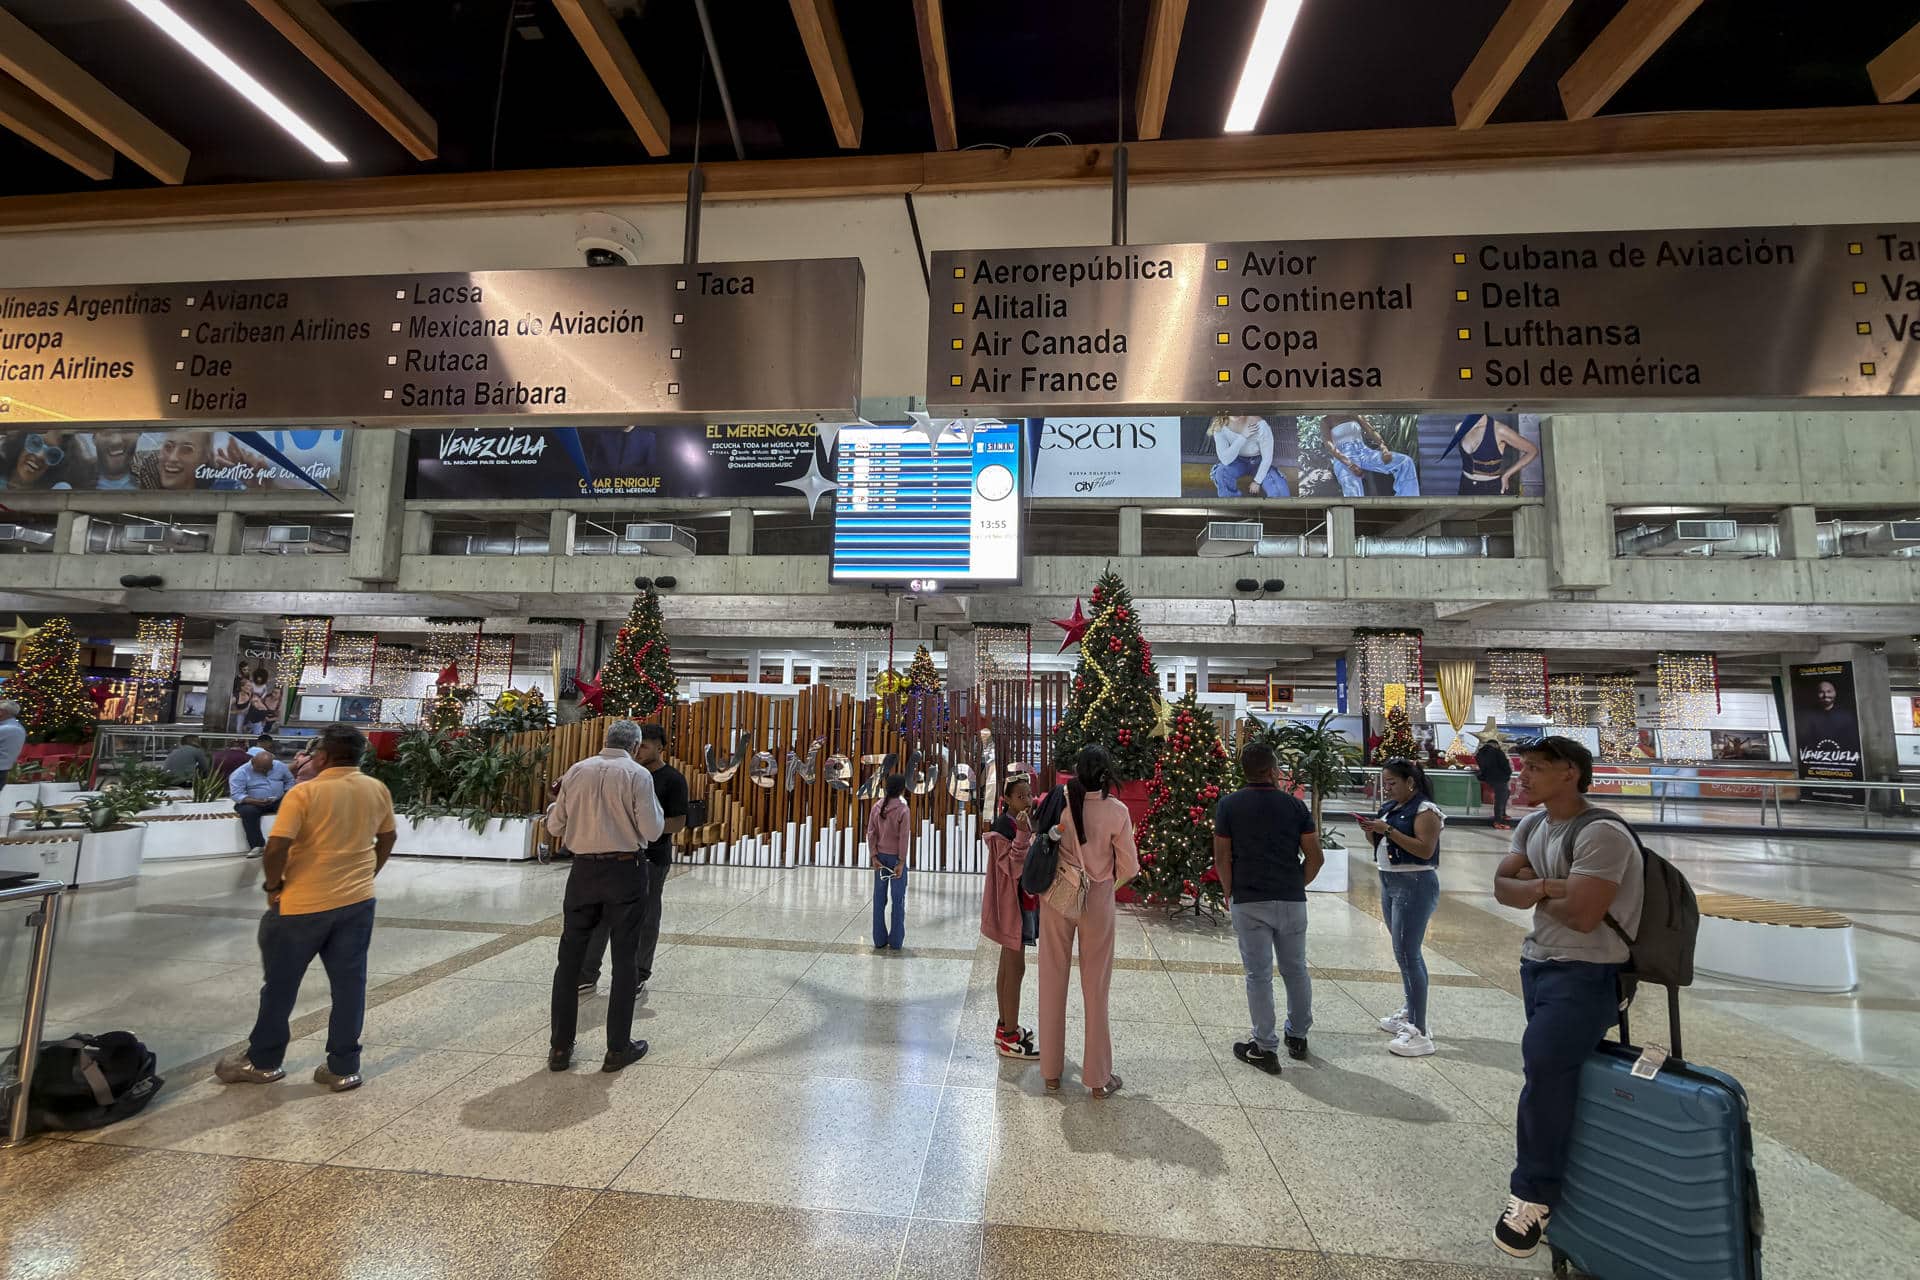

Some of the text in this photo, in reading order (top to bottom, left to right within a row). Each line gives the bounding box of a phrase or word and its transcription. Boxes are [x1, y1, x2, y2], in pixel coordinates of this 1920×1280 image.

[1478, 237, 1796, 272] Cubana de Aviación
[1876, 233, 1920, 262] Ta
[972, 255, 1174, 288] Aerorepública
[1241, 251, 1318, 276] Avior
[413, 281, 484, 306] Lacsa
[696, 272, 755, 296] Taca
[1481, 282, 1561, 309] Delta
[0, 293, 172, 322] líneas Argentinas
[200, 288, 290, 312] Avianca
[972, 293, 1069, 320] Alitalia
[1240, 283, 1414, 313] Continental
[195, 318, 371, 345] Caribean Airlines
[408, 310, 645, 339] Mexicana de Aviación
[1484, 320, 1642, 348] Lufthansa
[0, 328, 63, 354] uropa
[971, 329, 1129, 357] Air Canada
[1241, 325, 1319, 357] Copa
[50, 356, 135, 380] Airlines
[190, 355, 233, 378] Dae
[404, 348, 489, 373] Rutaca
[1485, 356, 1702, 387] Sol de América
[970, 366, 1119, 393] Air France
[1242, 362, 1383, 389] Conviasa
[184, 387, 248, 411] Iberia
[401, 381, 568, 408] Santa Bárbara
[440, 427, 549, 460] VENEZUELA
[706, 425, 722, 438] EL
[195, 461, 254, 480] Encuentros
[256, 465, 277, 486] que
[614, 476, 662, 488] ENRIQUE
[1074, 480, 1095, 492] City
[980, 520, 1007, 529] 13:55
[1800, 746, 1861, 762] VENEZUELA
